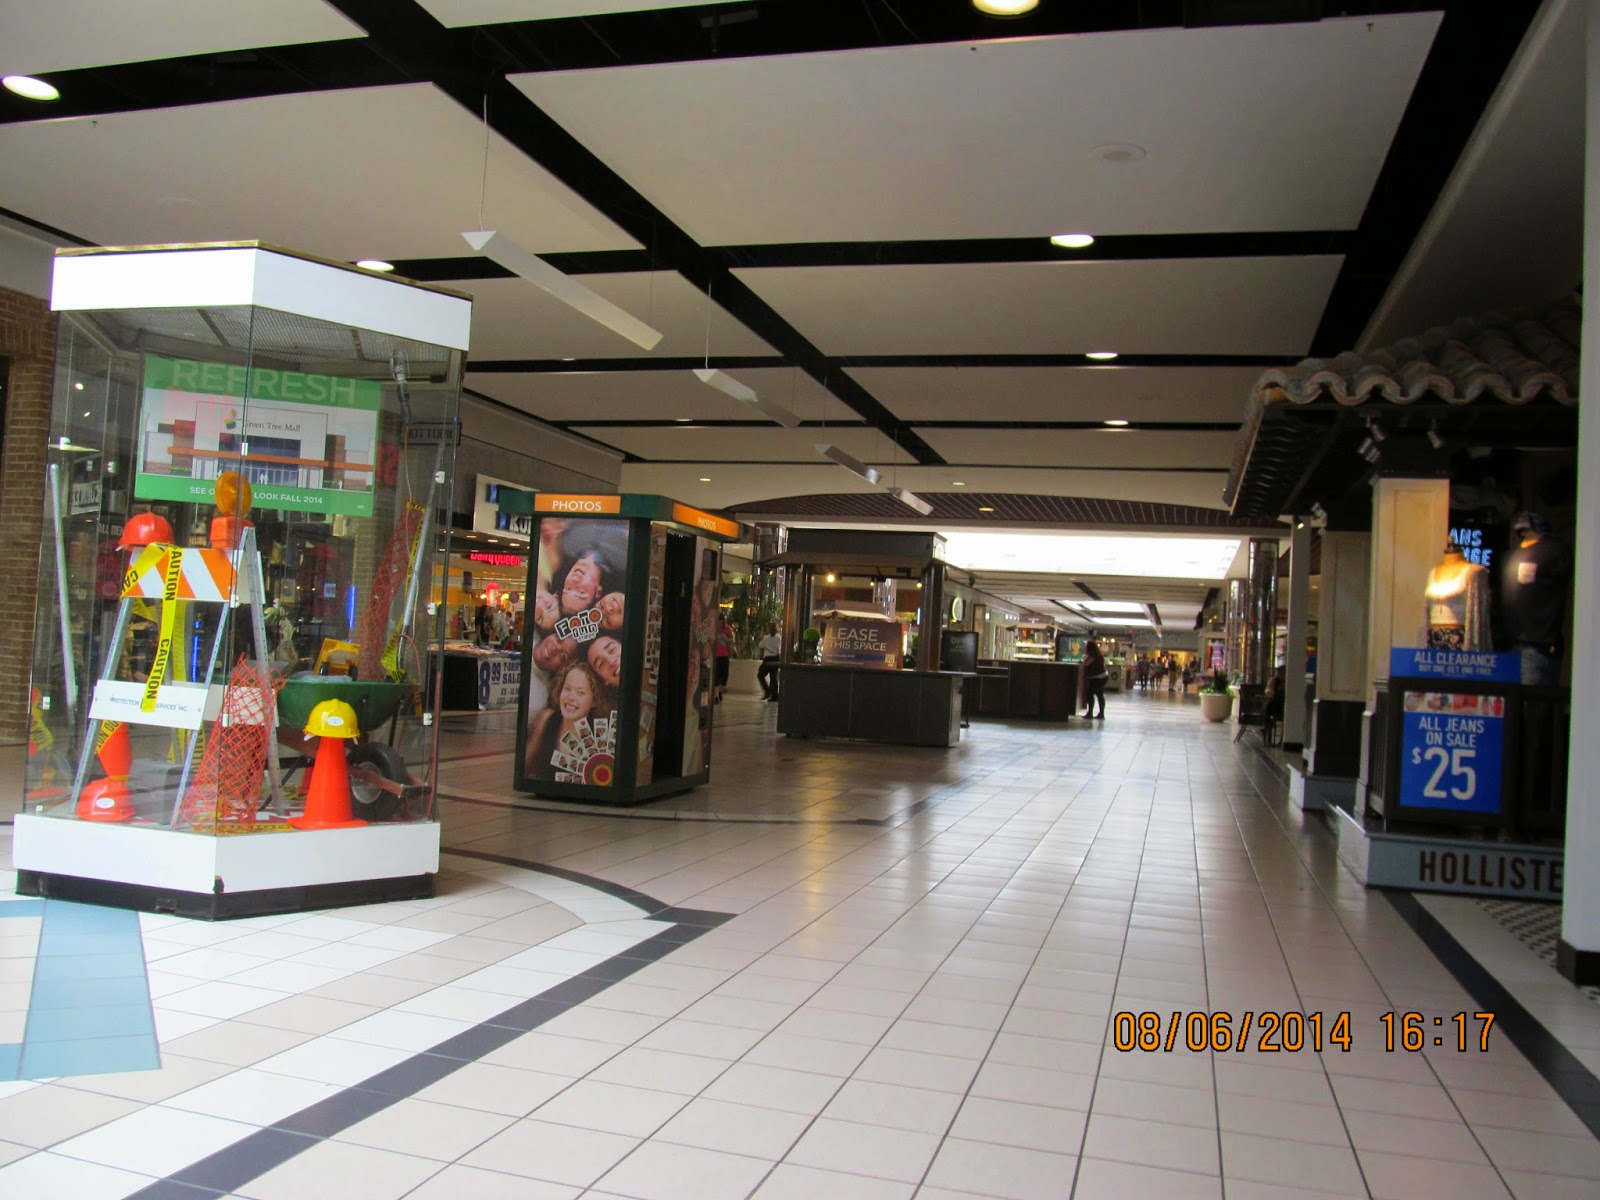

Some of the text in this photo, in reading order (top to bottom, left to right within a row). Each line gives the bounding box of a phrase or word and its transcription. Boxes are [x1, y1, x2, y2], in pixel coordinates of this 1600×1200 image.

[172, 359, 356, 404] REFRESH
[266, 422, 282, 430] Tree
[284, 424, 301, 432] Mall
[190, 487, 206, 495] SEE
[254, 492, 278, 501] LOOK
[280, 494, 301, 503] FALL
[304, 496, 323, 504] 2014
[552, 500, 601, 512] PHOTOS
[697, 516, 716, 531] PHOTOS
[829, 627, 879, 642] LEASE
[828, 640, 887, 652] THIS SPACE
[1414, 651, 1497, 667] ALL CLEARANCE
[146, 638, 170, 699] CAUTION
[156, 703, 177, 711] ERVICES
[1418, 717, 1484, 734] ALL JEANS
[1426, 732, 1476, 748] ON SALE
[1412, 746, 1477, 800] $25
[1419, 850, 1564, 894] HOLLISTE
